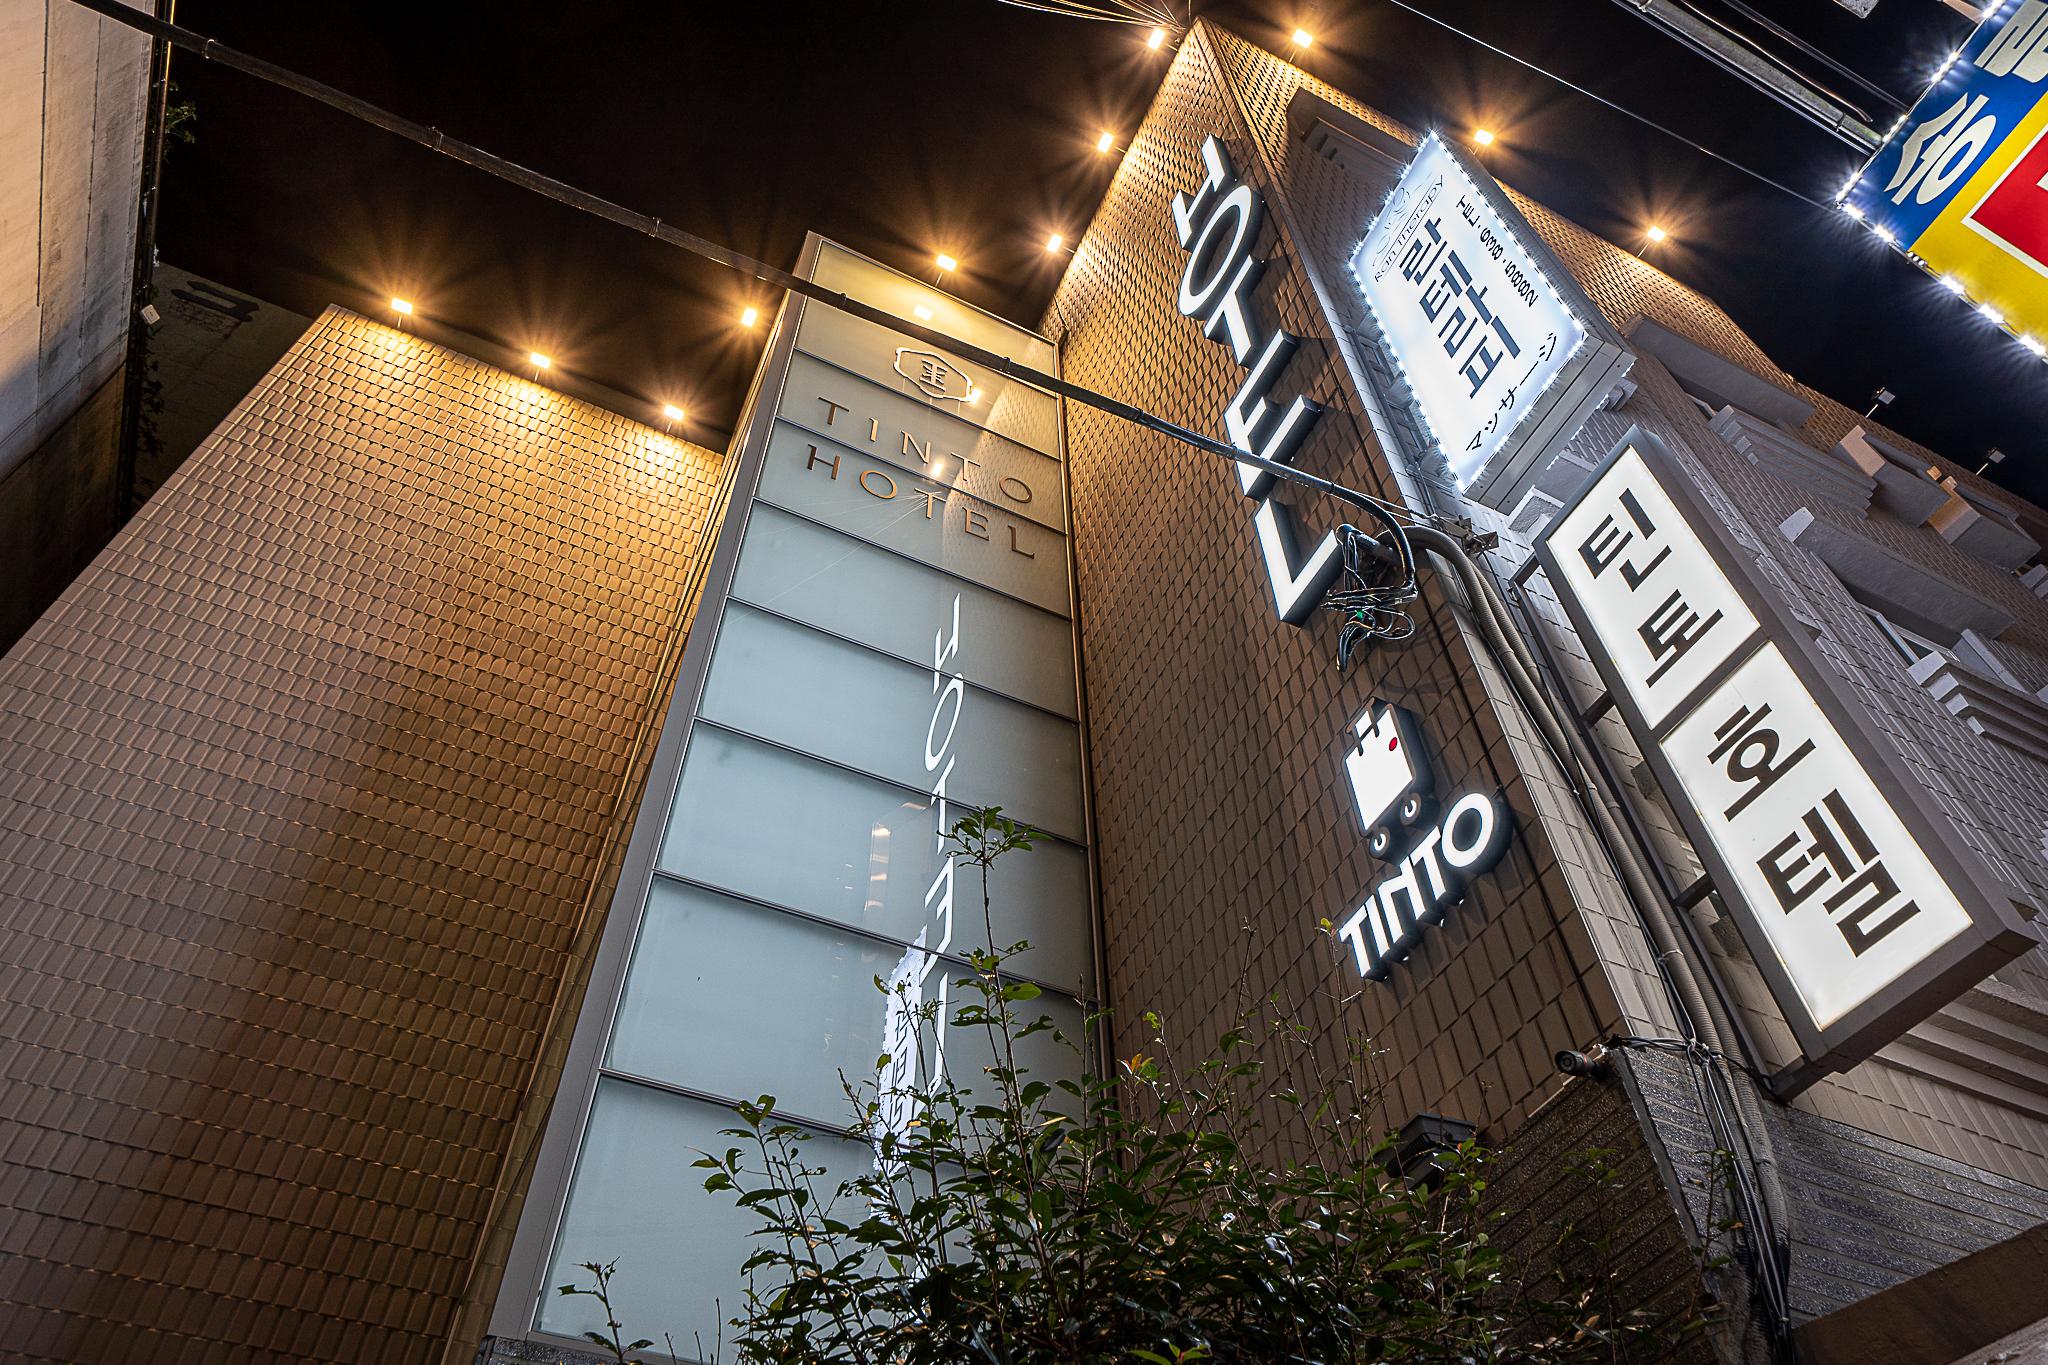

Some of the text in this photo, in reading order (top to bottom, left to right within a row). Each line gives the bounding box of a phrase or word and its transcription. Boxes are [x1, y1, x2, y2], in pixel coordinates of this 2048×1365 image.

[1172, 133, 1343, 622] HOTEL
[1399, 216, 1521, 400] 란테라피
[818, 396, 1033, 504] TINTO
[1465, 332, 1558, 452] マッサージ
[807, 443, 1035, 560] HOTEL
[1577, 487, 1922, 959] 틴토 호텔
